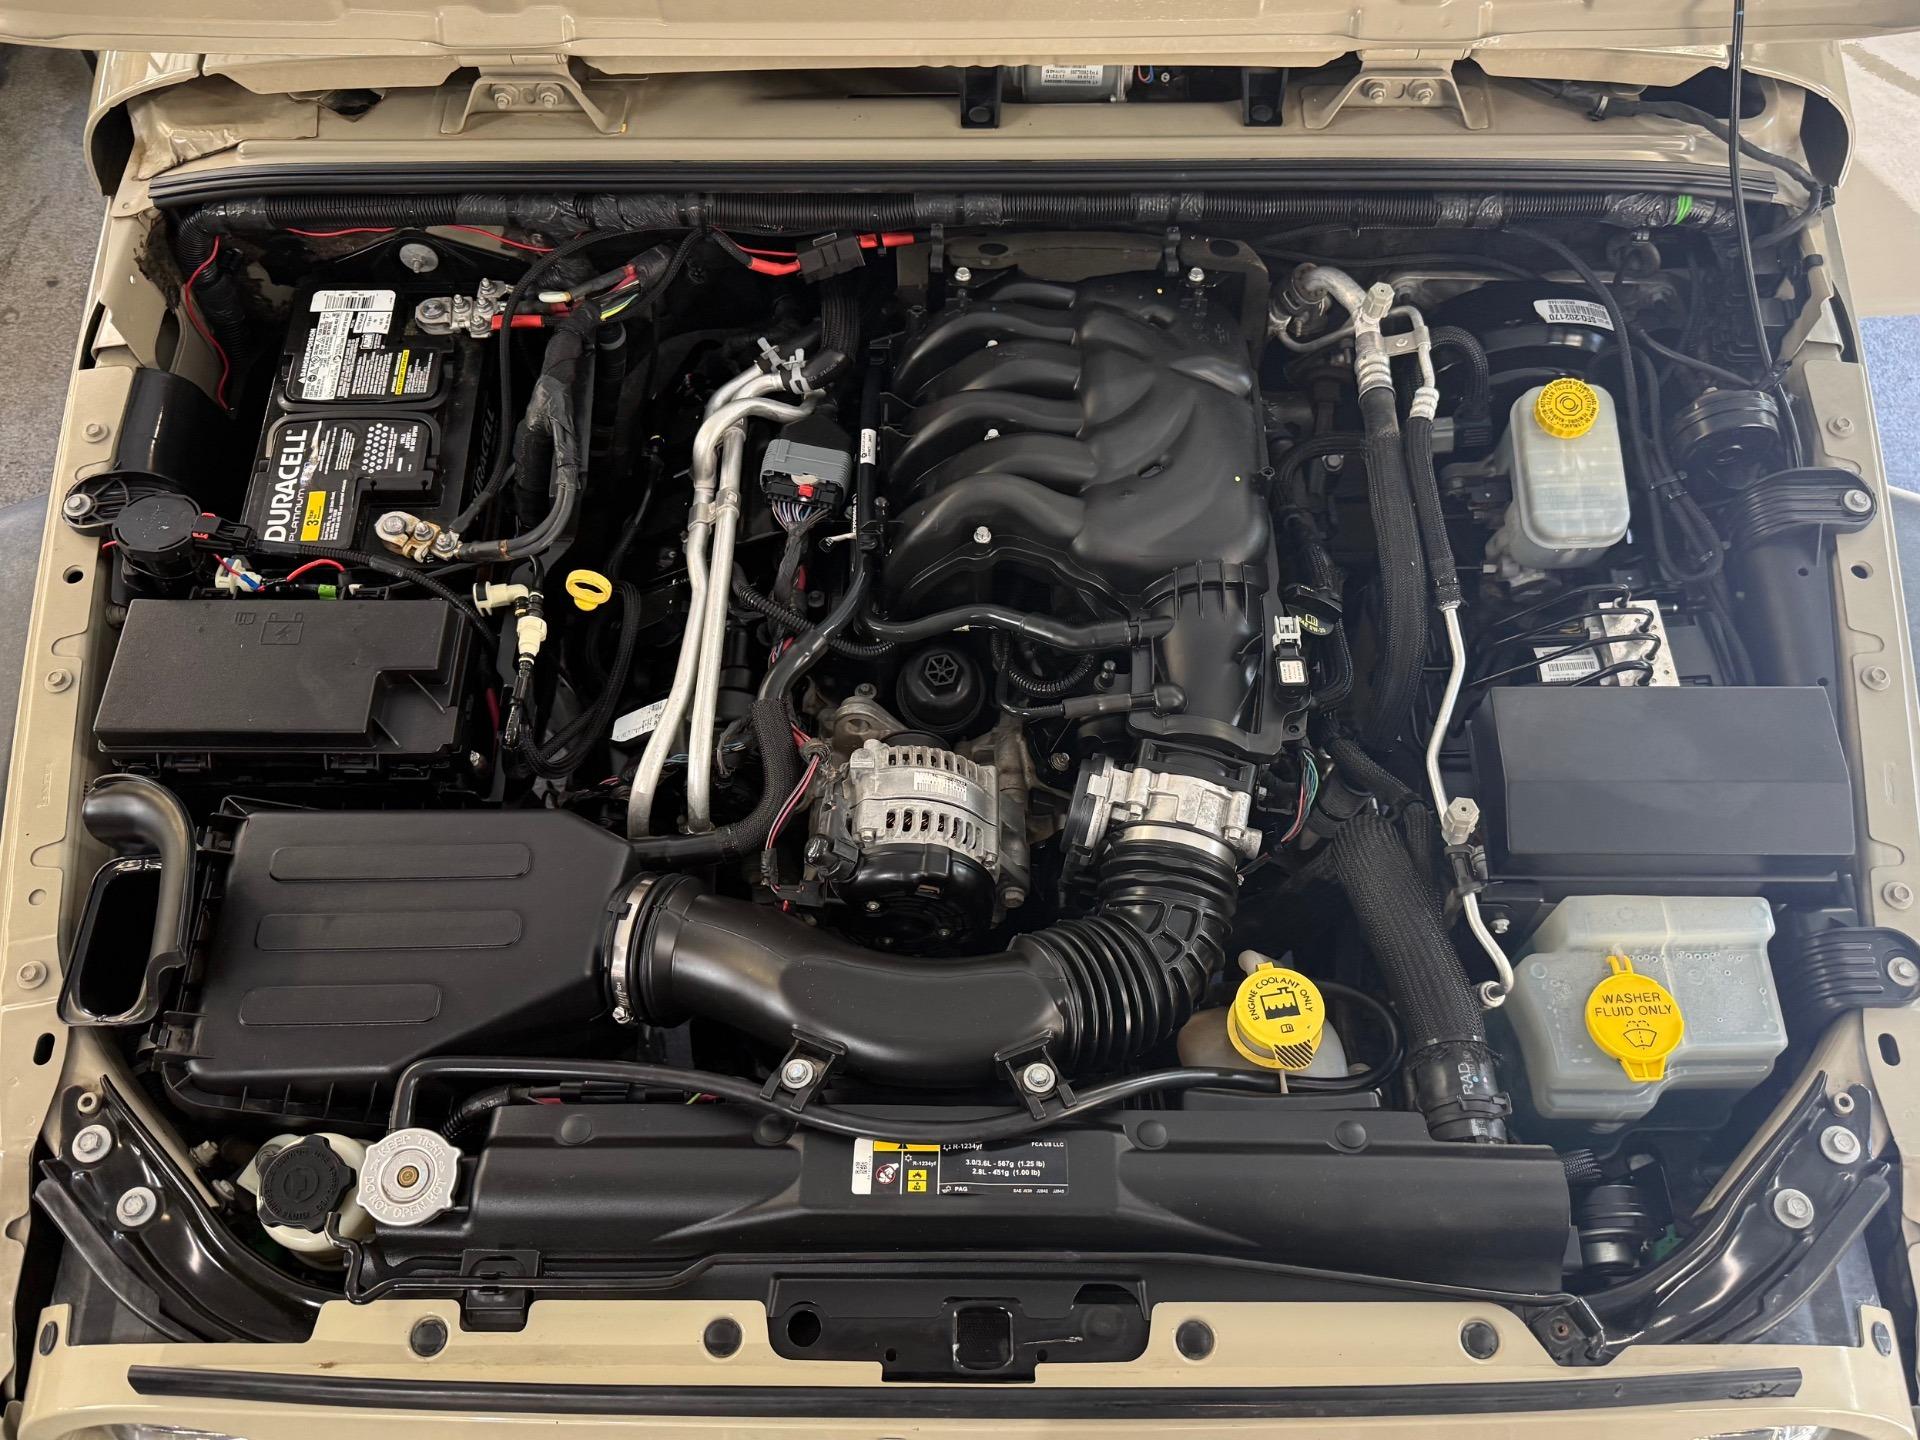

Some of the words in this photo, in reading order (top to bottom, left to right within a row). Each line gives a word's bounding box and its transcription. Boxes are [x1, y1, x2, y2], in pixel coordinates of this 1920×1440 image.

[473, 405, 496, 496] URACELL
[263, 429, 308, 542] DURACELL
[288, 488, 305, 542] PLATINUM
[1247, 989, 1260, 1021] ENGINE
[1256, 976, 1300, 989] COOLANT
[1300, 989, 1313, 1012] ONLY
[1602, 992, 1661, 1004] WASHER
[1594, 1006, 1634, 1017] FLUID
[1638, 1005, 1672, 1016] ONLY
[1457, 1062, 1474, 1095] RAD
[378, 1134, 411, 1157] KEEP
[417, 1134, 445, 1157] TIGHT
[1012, 1169, 1030, 1177] (1.00
[1030, 1169, 1041, 1177] lb)
[1017, 1160, 1035, 1168] (1.25
[1035, 1160, 1046, 1168] lb)
[365, 1176, 376, 1193] DO
[426, 1178, 447, 1204] HOT
[368, 1193, 391, 1215] NOT
[393, 1202, 427, 1218] OPEN
